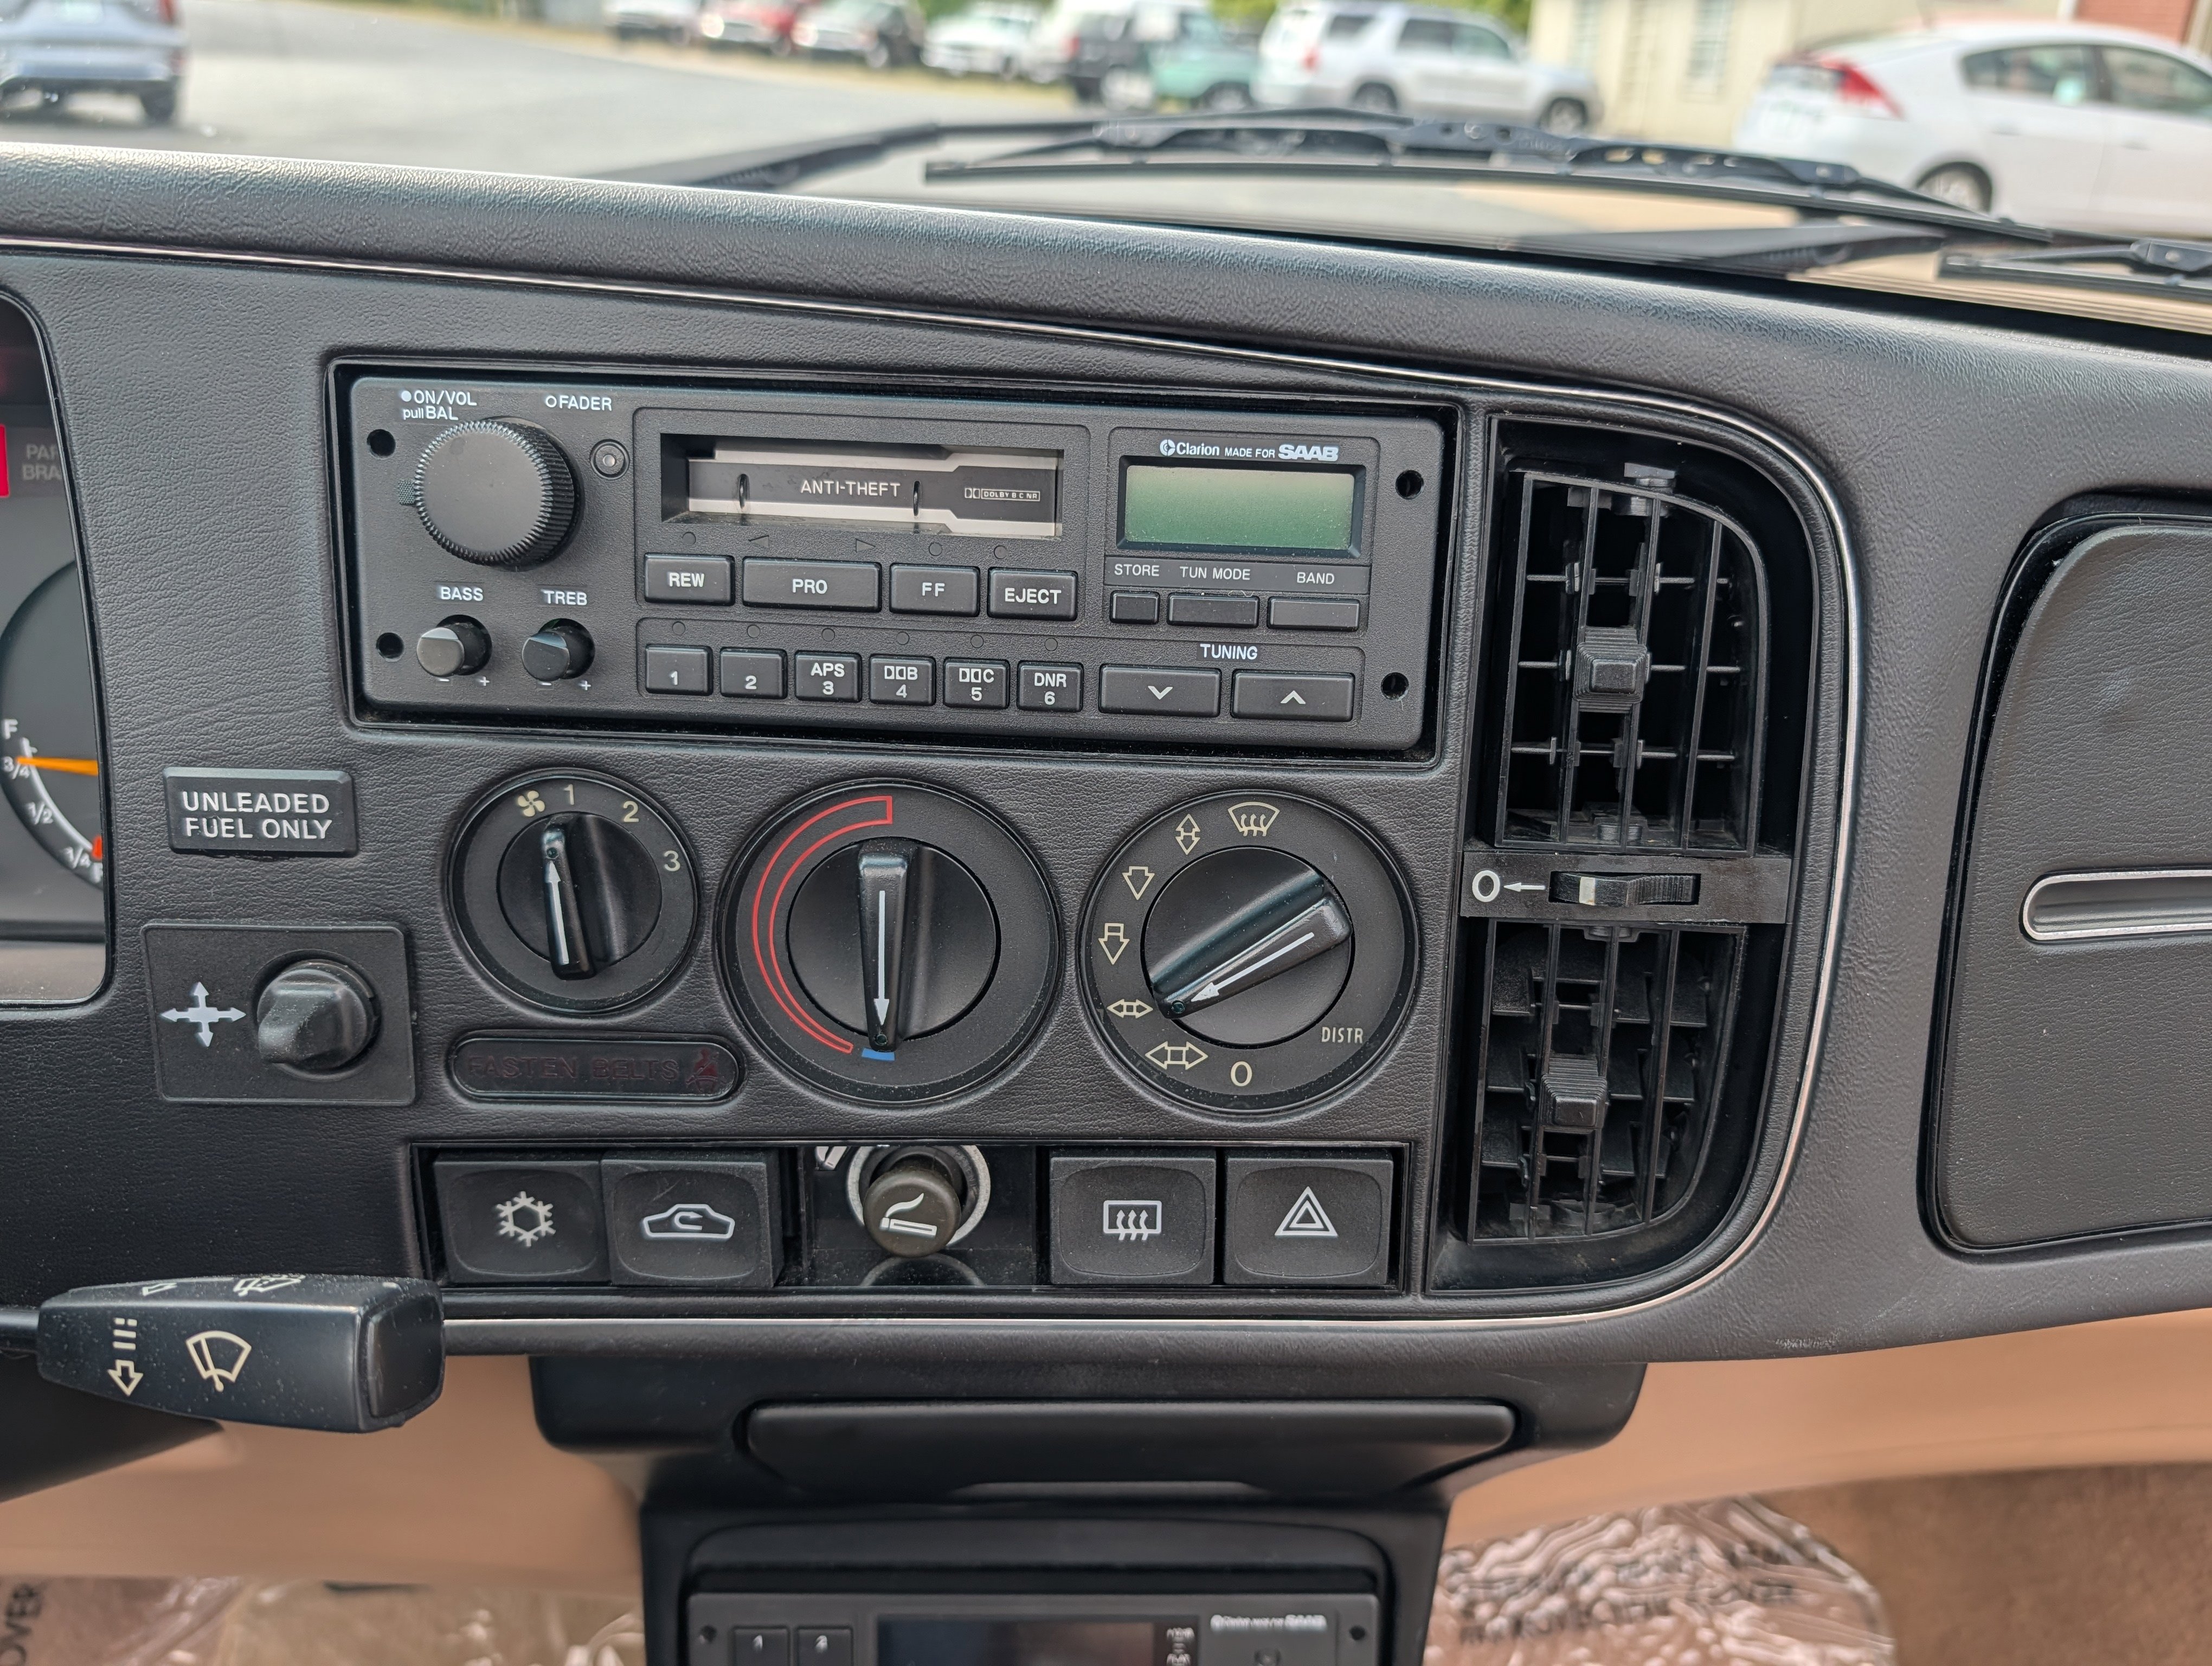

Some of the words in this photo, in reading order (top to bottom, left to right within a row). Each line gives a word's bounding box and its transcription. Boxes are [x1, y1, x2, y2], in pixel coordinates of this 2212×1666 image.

[414, 389, 477, 406] ON/VOL
[559, 395, 612, 411] FADER
[403, 407, 424, 420] pull
[426, 405, 459, 420] BAL
[1176, 442, 1220, 456] Clarion
[1224, 447, 1252, 458] MADE
[1255, 448, 1275, 458] FOR
[1278, 444, 1340, 462] SAAB
[800, 480, 901, 497] ANTI-THEFT
[1114, 563, 1160, 576] STORE
[1179, 566, 1207, 579] TUN
[1212, 567, 1251, 581] MODE
[668, 572, 705, 588] REW
[792, 578, 828, 594] PRO
[1297, 572, 1335, 585] BAND
[440, 586, 484, 601] BASS
[922, 582, 945, 597] FF
[1005, 587, 1062, 605] EJECT
[543, 590, 588, 606] TREB
[1200, 643, 1258, 660] TUNING
[670, 671, 678, 685] 1
[811, 662, 845, 678] APS
[745, 675, 757, 690] 2
[822, 681, 834, 695] 3
[1034, 672, 1066, 688] DNR
[896, 684, 908, 699] 4
[971, 687, 982, 701] 5
[1044, 691, 1055, 705] 6
[3, 719, 18, 739] F
[182, 791, 330, 814] UNLEADED
[563, 784, 575, 805] 1
[623, 800, 640, 823] 2
[185, 817, 253, 838] FUEL
[261, 818, 332, 840] ONLY
[663, 850, 680, 872] 3
[1321, 1026, 1364, 1044] DISTR
[468, 1055, 577, 1079] FASTEN
[593, 1058, 680, 1081] BELTS
